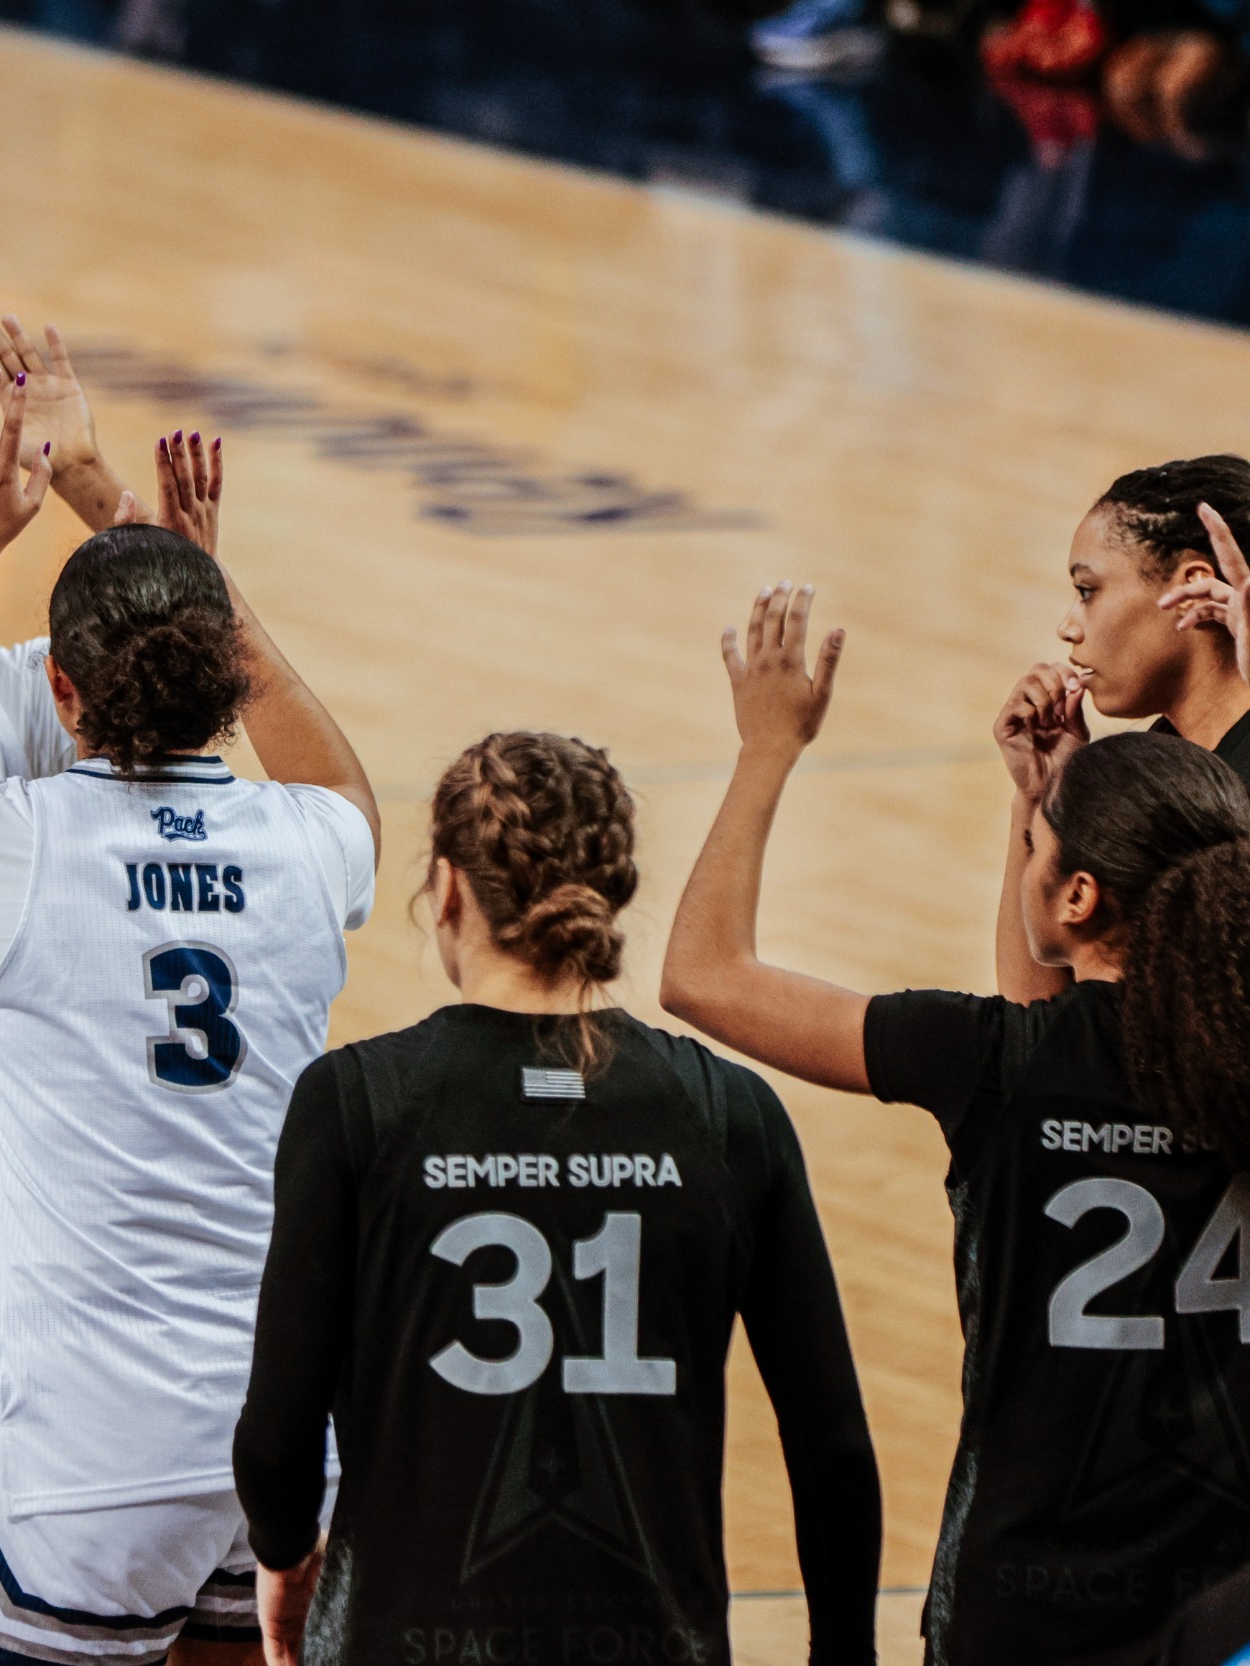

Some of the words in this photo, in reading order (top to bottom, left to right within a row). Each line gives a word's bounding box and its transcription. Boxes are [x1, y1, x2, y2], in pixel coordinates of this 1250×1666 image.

[150, 806, 208, 842] Pack
[123, 862, 247, 914] JONES
[142, 939, 248, 1095] 3
[1039, 1117, 1174, 1156] SEMPER
[424, 1153, 561, 1189] SEMPER
[567, 1152, 683, 1188] SUPRA
[428, 1209, 678, 1396] 31
[403, 1626, 542, 1665] SPACE
